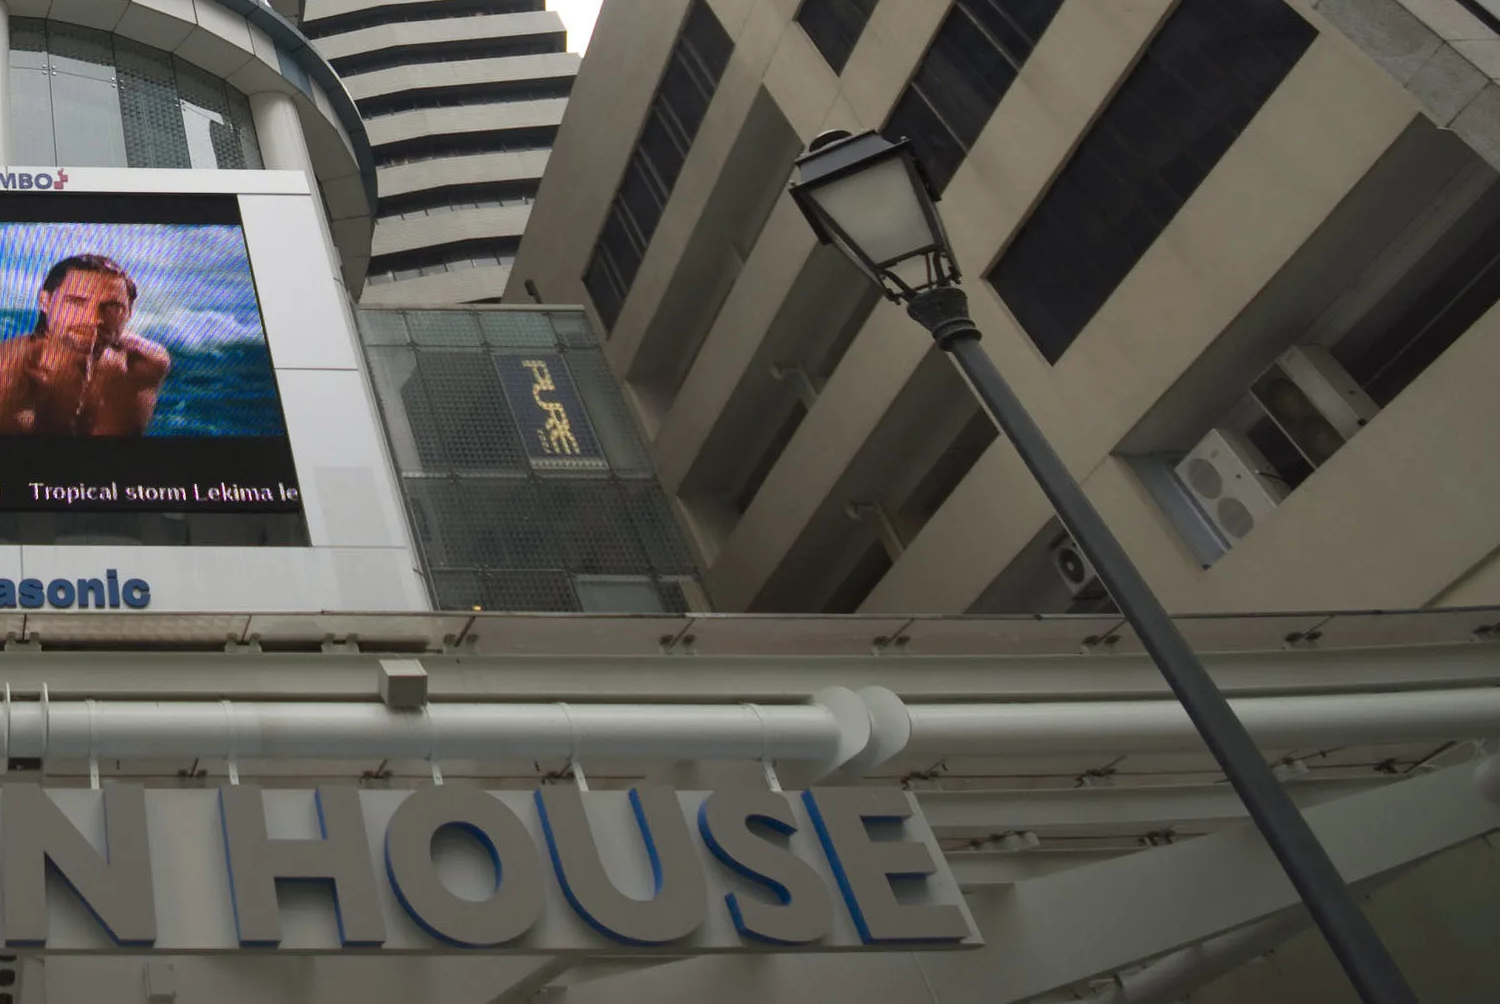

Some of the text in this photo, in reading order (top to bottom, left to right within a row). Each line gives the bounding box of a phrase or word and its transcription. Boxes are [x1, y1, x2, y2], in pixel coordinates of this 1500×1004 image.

[522, 359, 580, 454] PURE
[29, 482, 118, 504] Tropical
[125, 485, 187, 501] storm
[194, 482, 274, 502] Lekima
[218, 783, 970, 946] HOUSE
